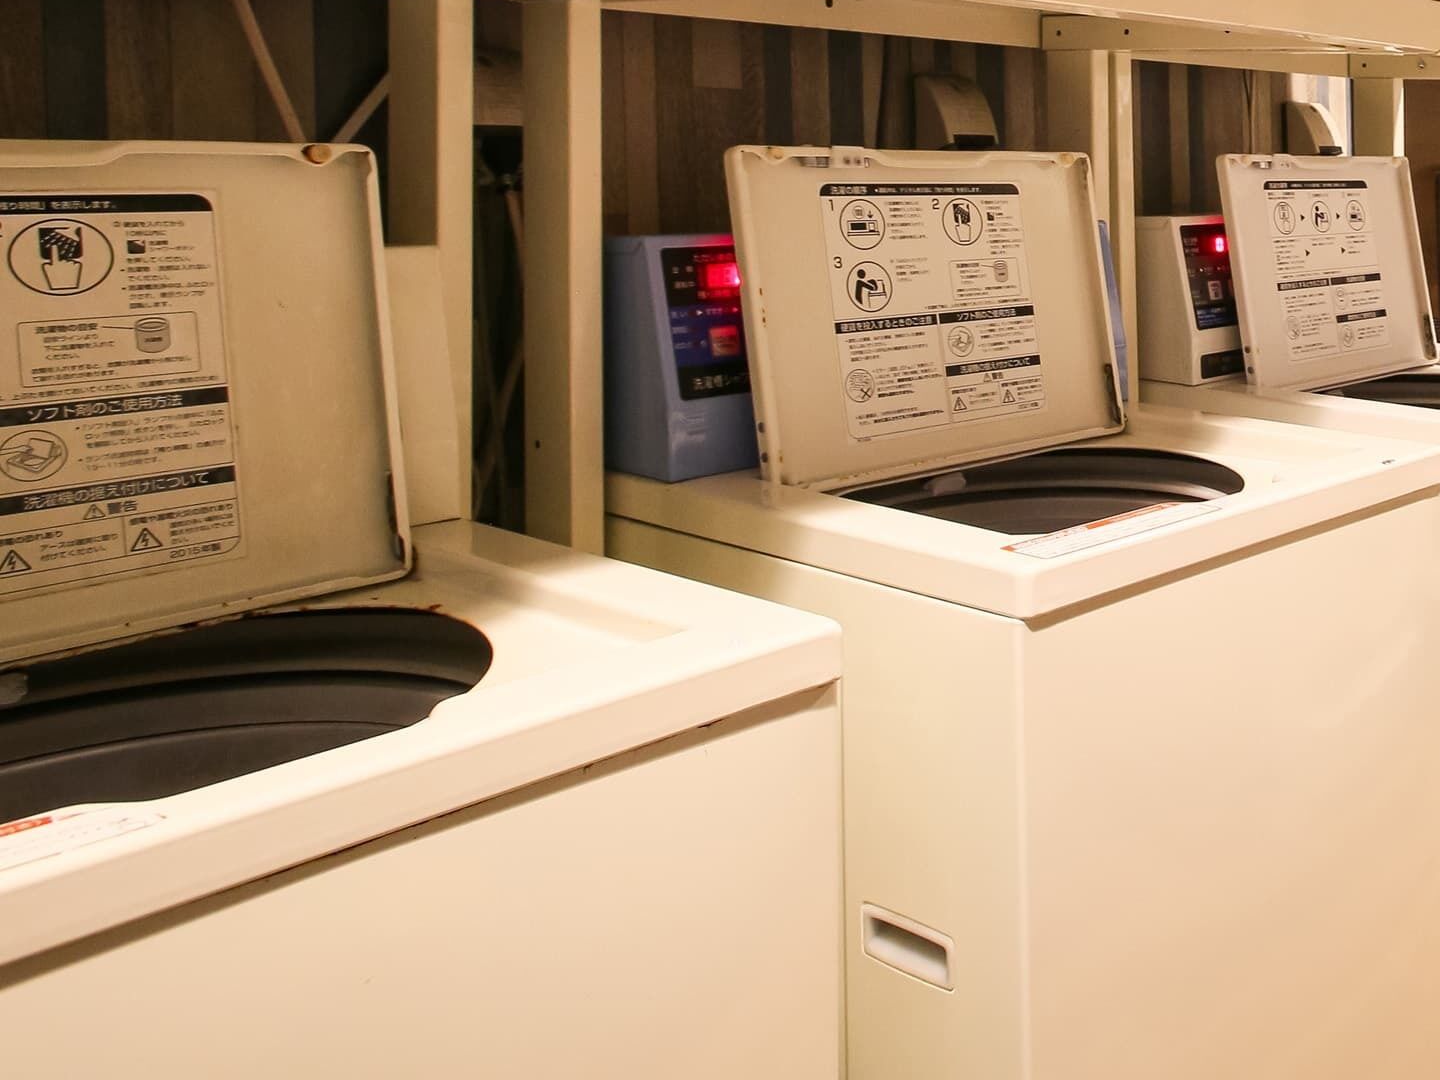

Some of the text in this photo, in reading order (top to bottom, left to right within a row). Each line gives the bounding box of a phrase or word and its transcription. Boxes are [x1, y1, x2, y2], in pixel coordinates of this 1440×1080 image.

[828, 199, 834, 211] 1
[931, 198, 940, 210] 2
[833, 256, 843, 269] 3
[27, 395, 183, 420] ソフト剤のご使用方法
[24, 472, 209, 510] 洗濯機の据え付けについて
[107, 501, 138, 515] 警告
